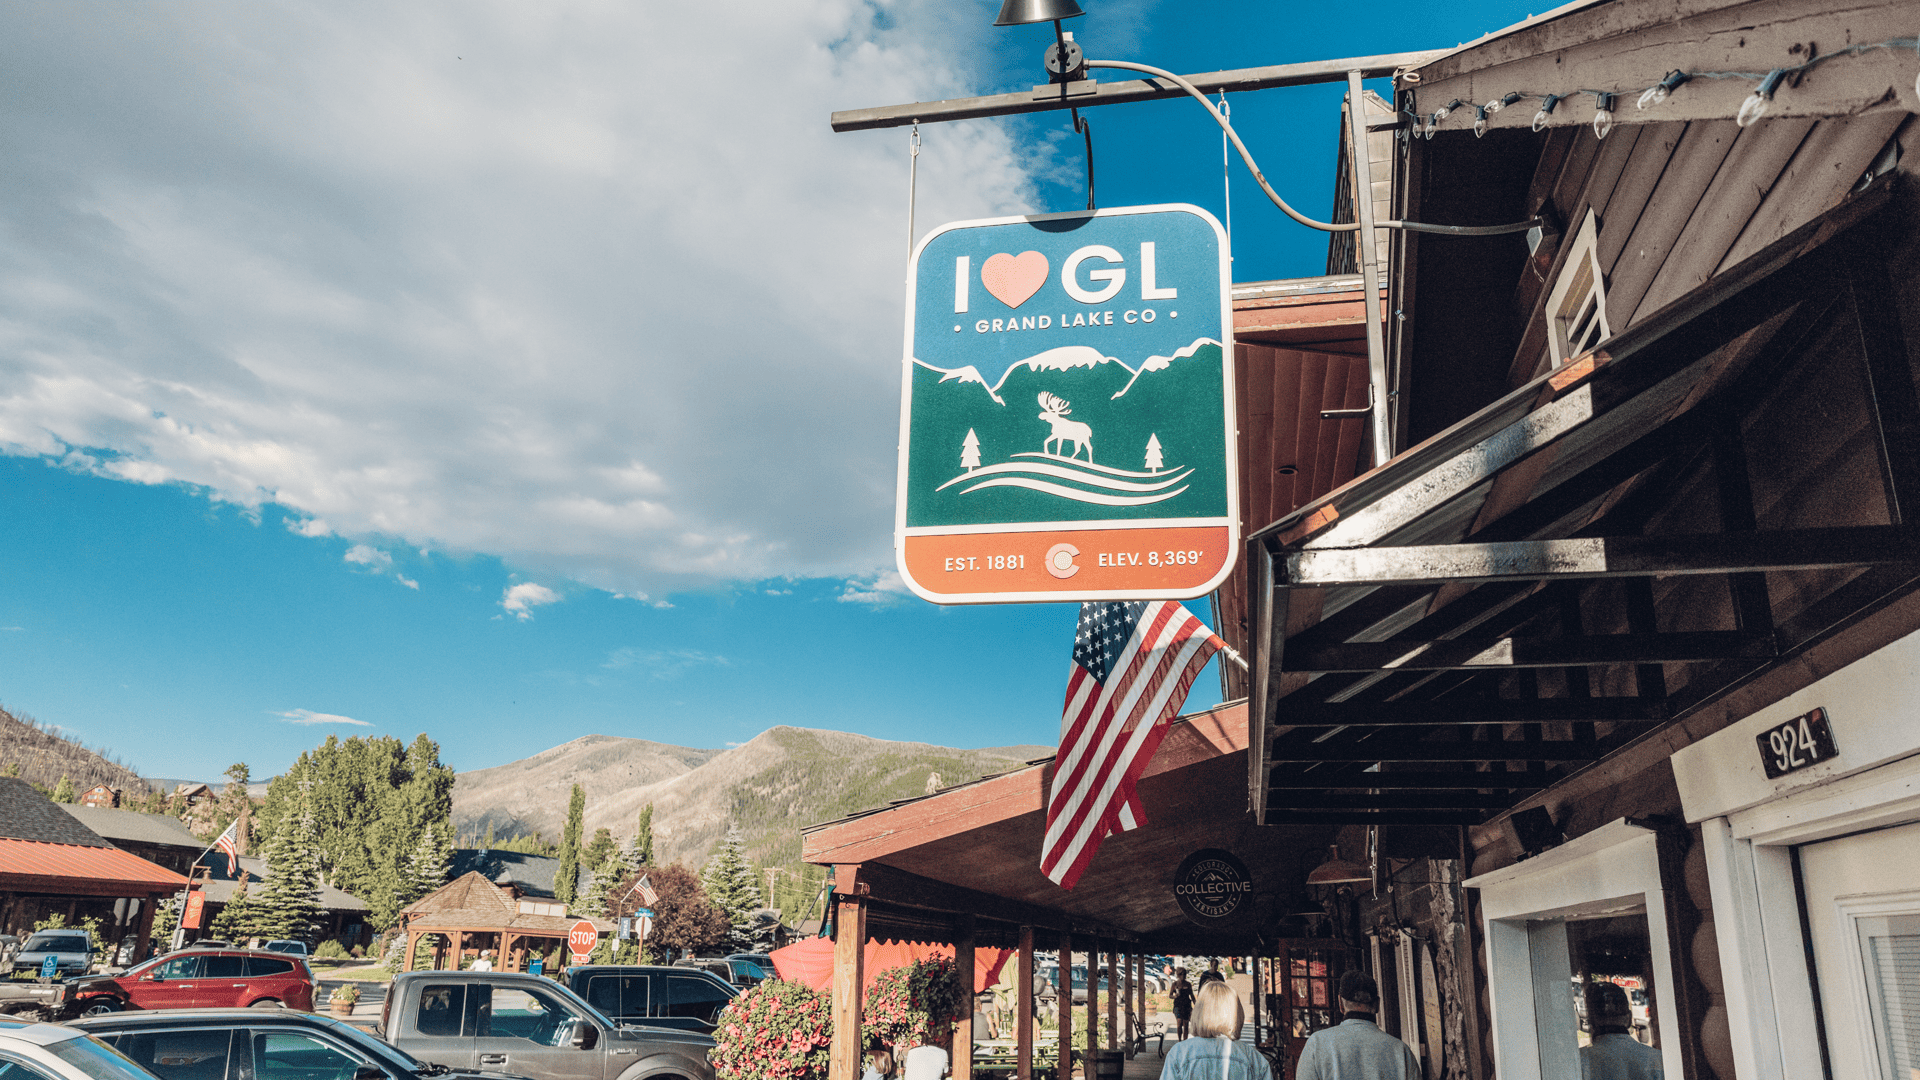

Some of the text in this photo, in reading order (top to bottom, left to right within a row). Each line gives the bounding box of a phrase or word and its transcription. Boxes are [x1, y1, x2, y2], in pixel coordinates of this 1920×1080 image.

[954, 241, 1178, 314] I GL
[975, 308, 1157, 334] GRAND LAKE CO
[944, 556, 981, 572] EST.
[986, 554, 1025, 570] 1881
[1098, 551, 1143, 567] ELEV.
[1147, 550, 1203, 567] 8,369'
[1769, 716, 1818, 771] 924
[1193, 861, 1230, 874] COLORADO
[1176, 881, 1251, 895] COLLECTIVE
[1195, 900, 1235, 915] ARTISAN'S
[570, 931, 596, 945] STOP
